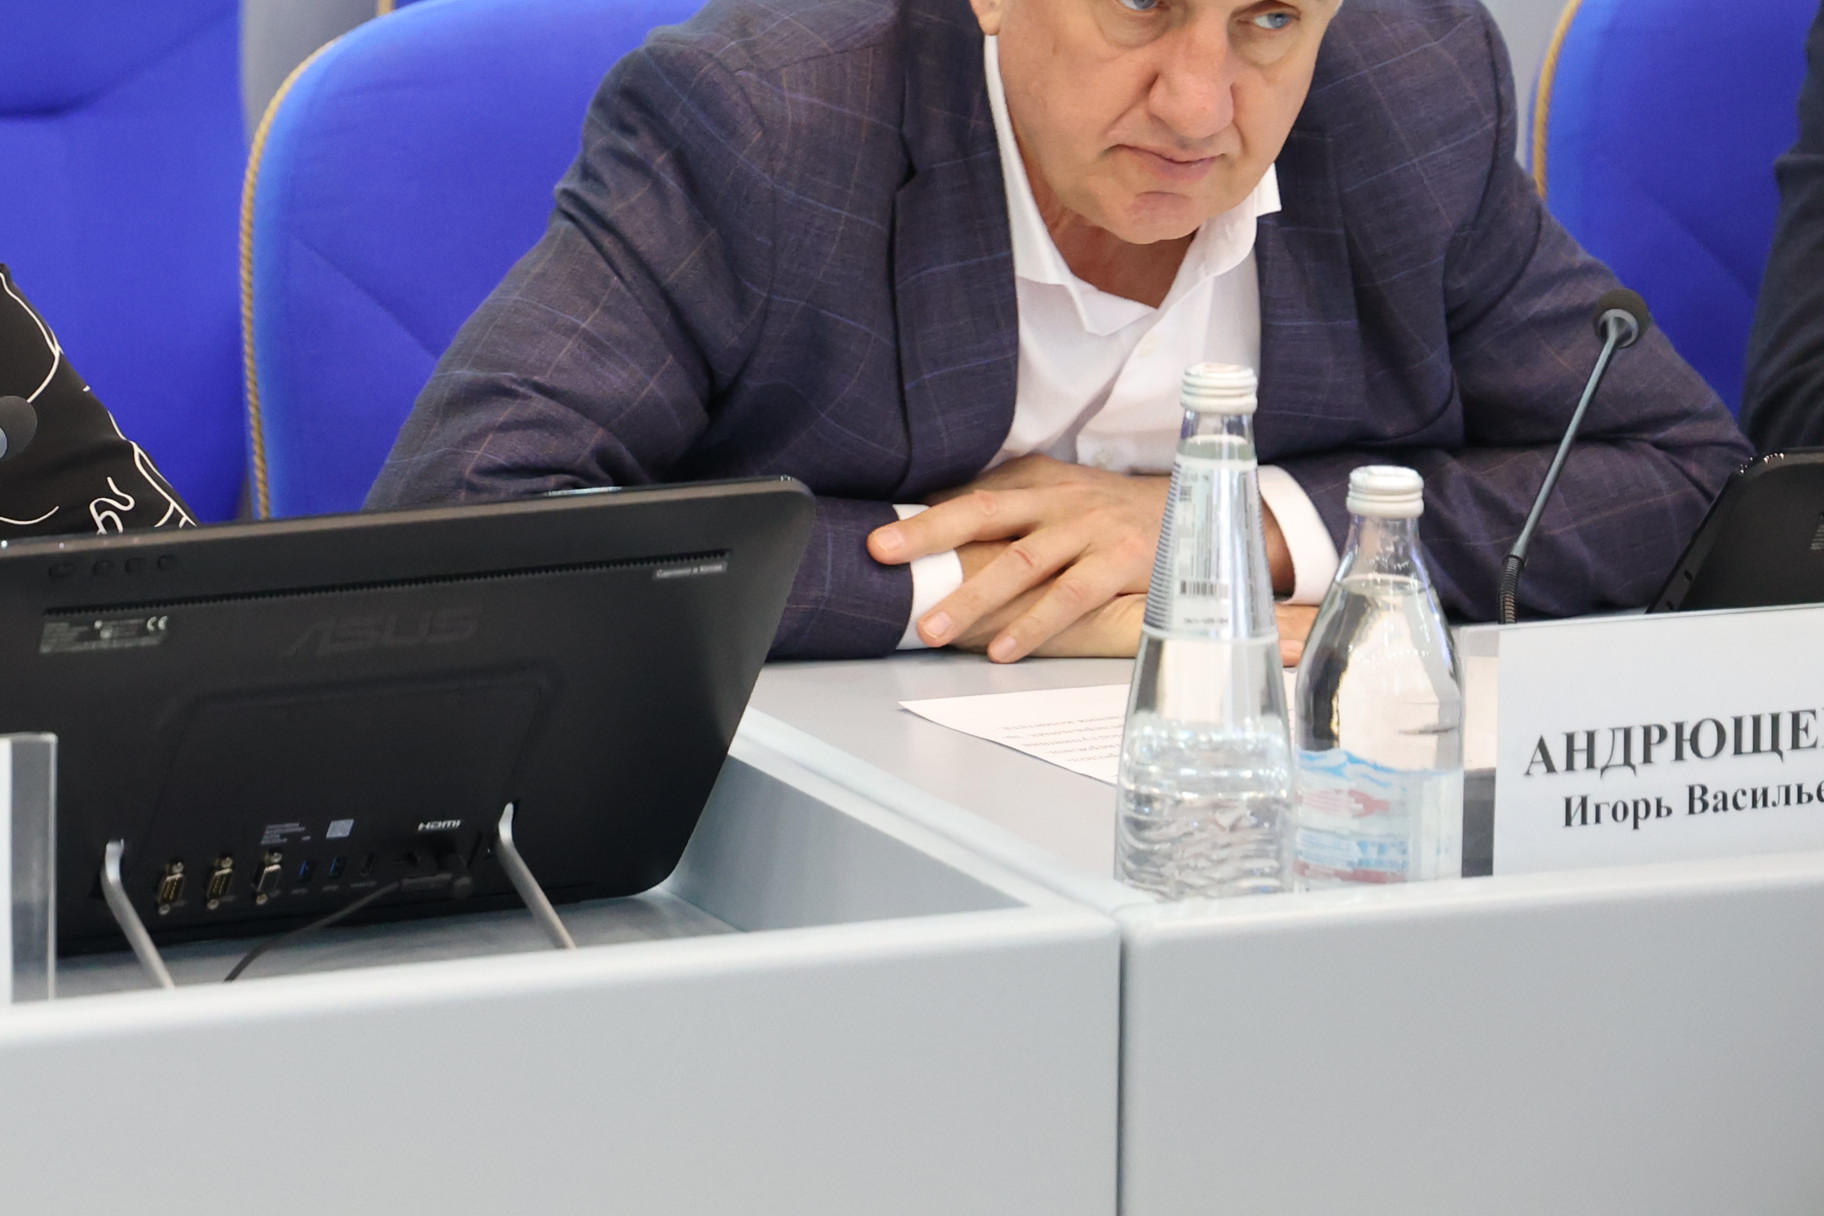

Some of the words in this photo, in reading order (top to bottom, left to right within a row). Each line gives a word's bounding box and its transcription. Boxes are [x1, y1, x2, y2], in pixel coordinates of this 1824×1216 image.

[281, 607, 481, 658] ASUS
[1523, 707, 1824, 780] АНДРЮЩЕ
[1563, 794, 1674, 831] Игорь
